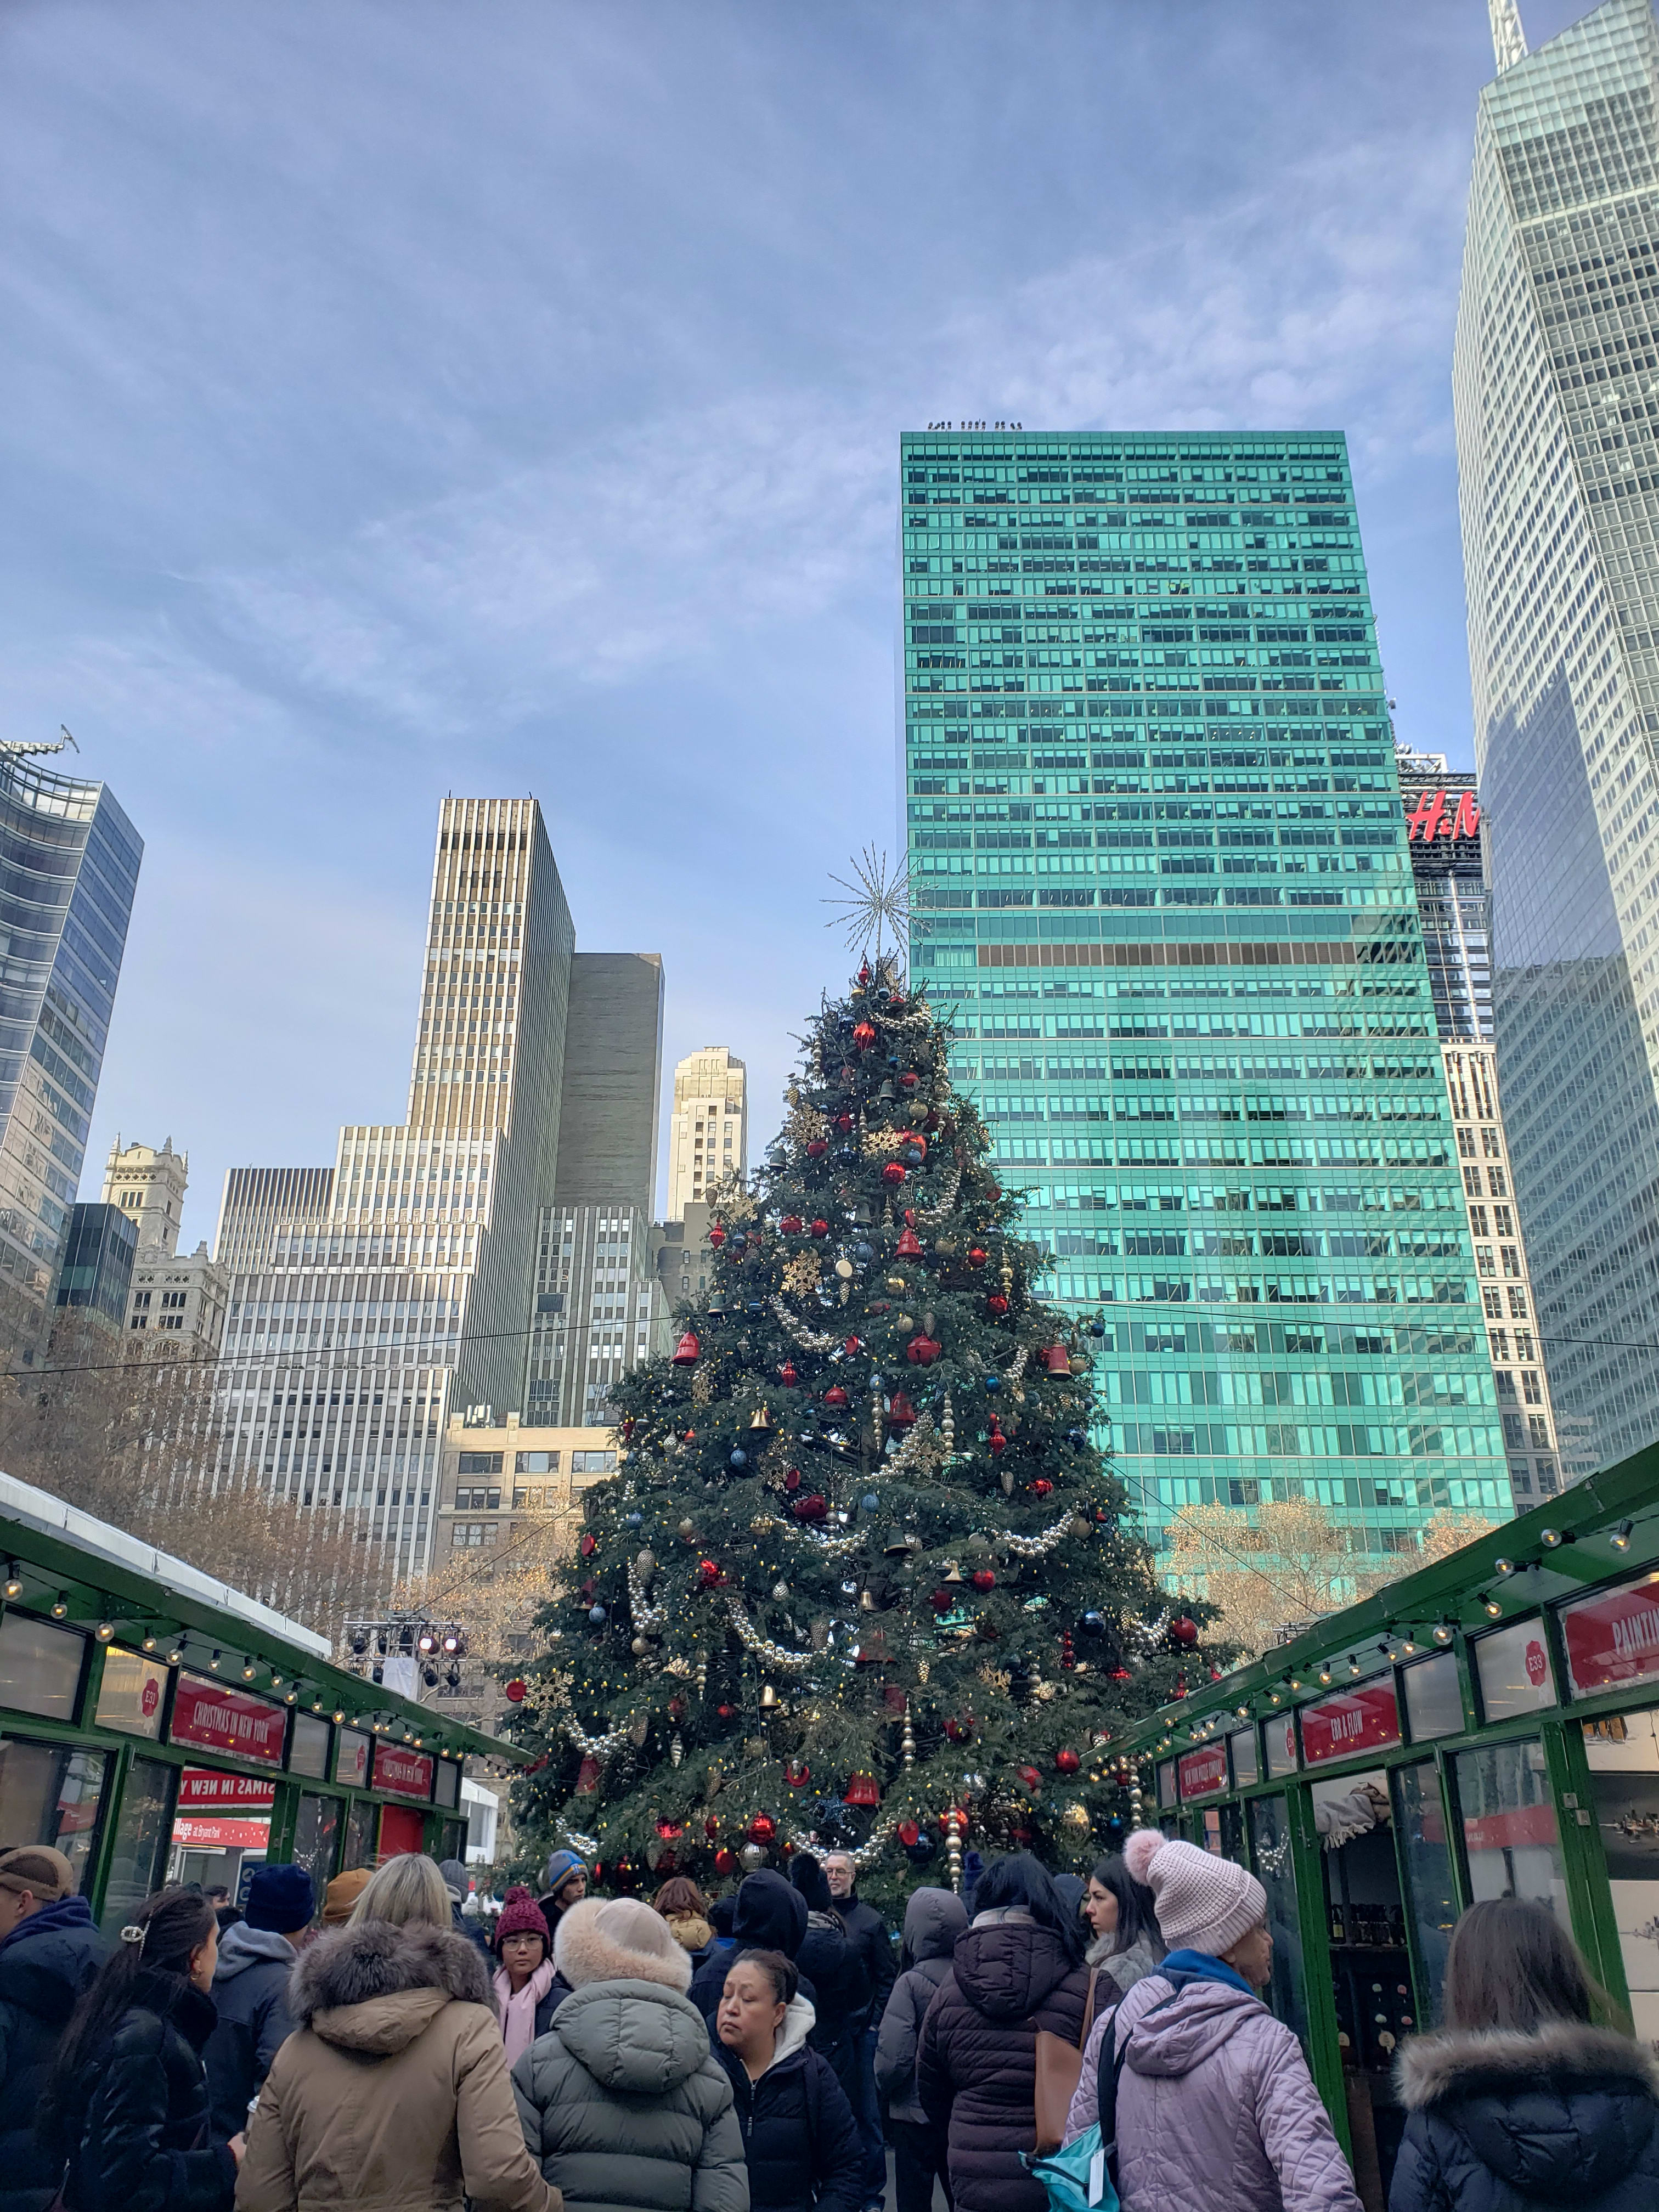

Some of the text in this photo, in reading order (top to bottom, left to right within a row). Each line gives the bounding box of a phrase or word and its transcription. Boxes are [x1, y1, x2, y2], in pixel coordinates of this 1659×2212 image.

[1406, 791, 1480, 842] H&M
[1528, 1654, 1543, 1672] E33
[145, 1690, 156, 1705] E31
[194, 1701, 270, 1743] CHRISTMAS IN NEW YORK
[1331, 1709, 1363, 1741] EBB & FLOW
[193, 1825, 198, 1837] at
[198, 1824, 211, 1841] Bryant
[211, 1826, 219, 1839] Park
